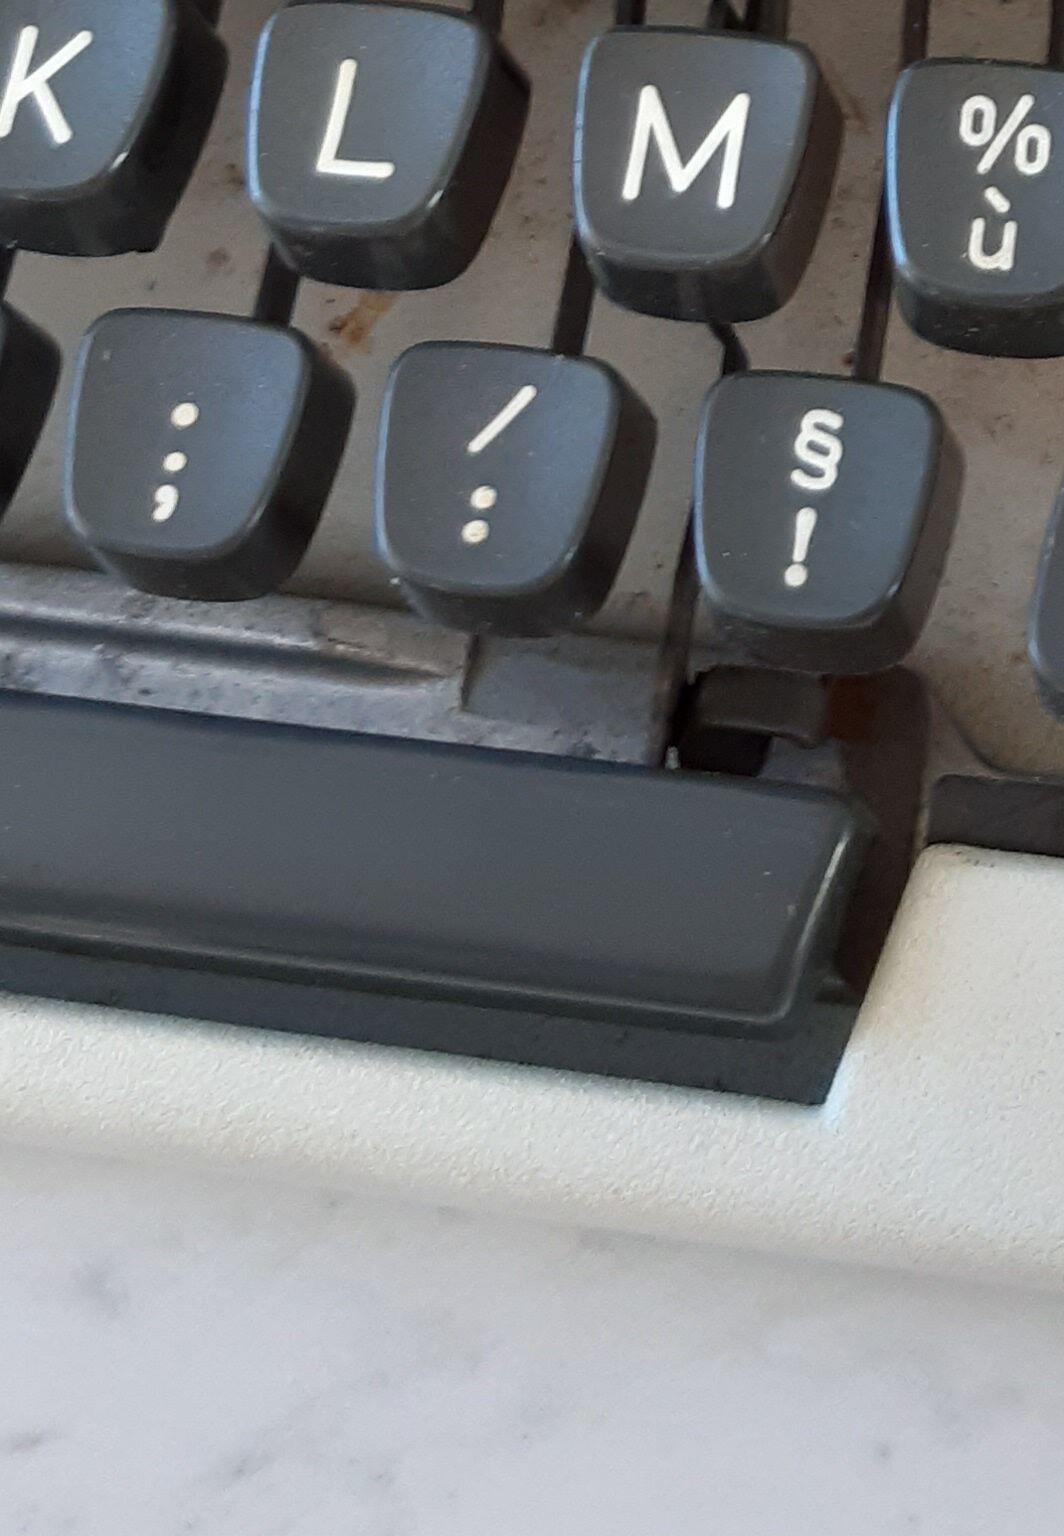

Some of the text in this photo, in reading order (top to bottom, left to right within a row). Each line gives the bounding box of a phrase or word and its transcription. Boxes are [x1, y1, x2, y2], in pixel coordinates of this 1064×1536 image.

[0, 24, 93, 145] K
[314, 58, 395, 180] L
[621, 84, 751, 211] M
[958, 94, 1052, 177] %
[967, 186, 1018, 272] ù
[789, 408, 844, 492] §
[783, 506, 818, 588] !
